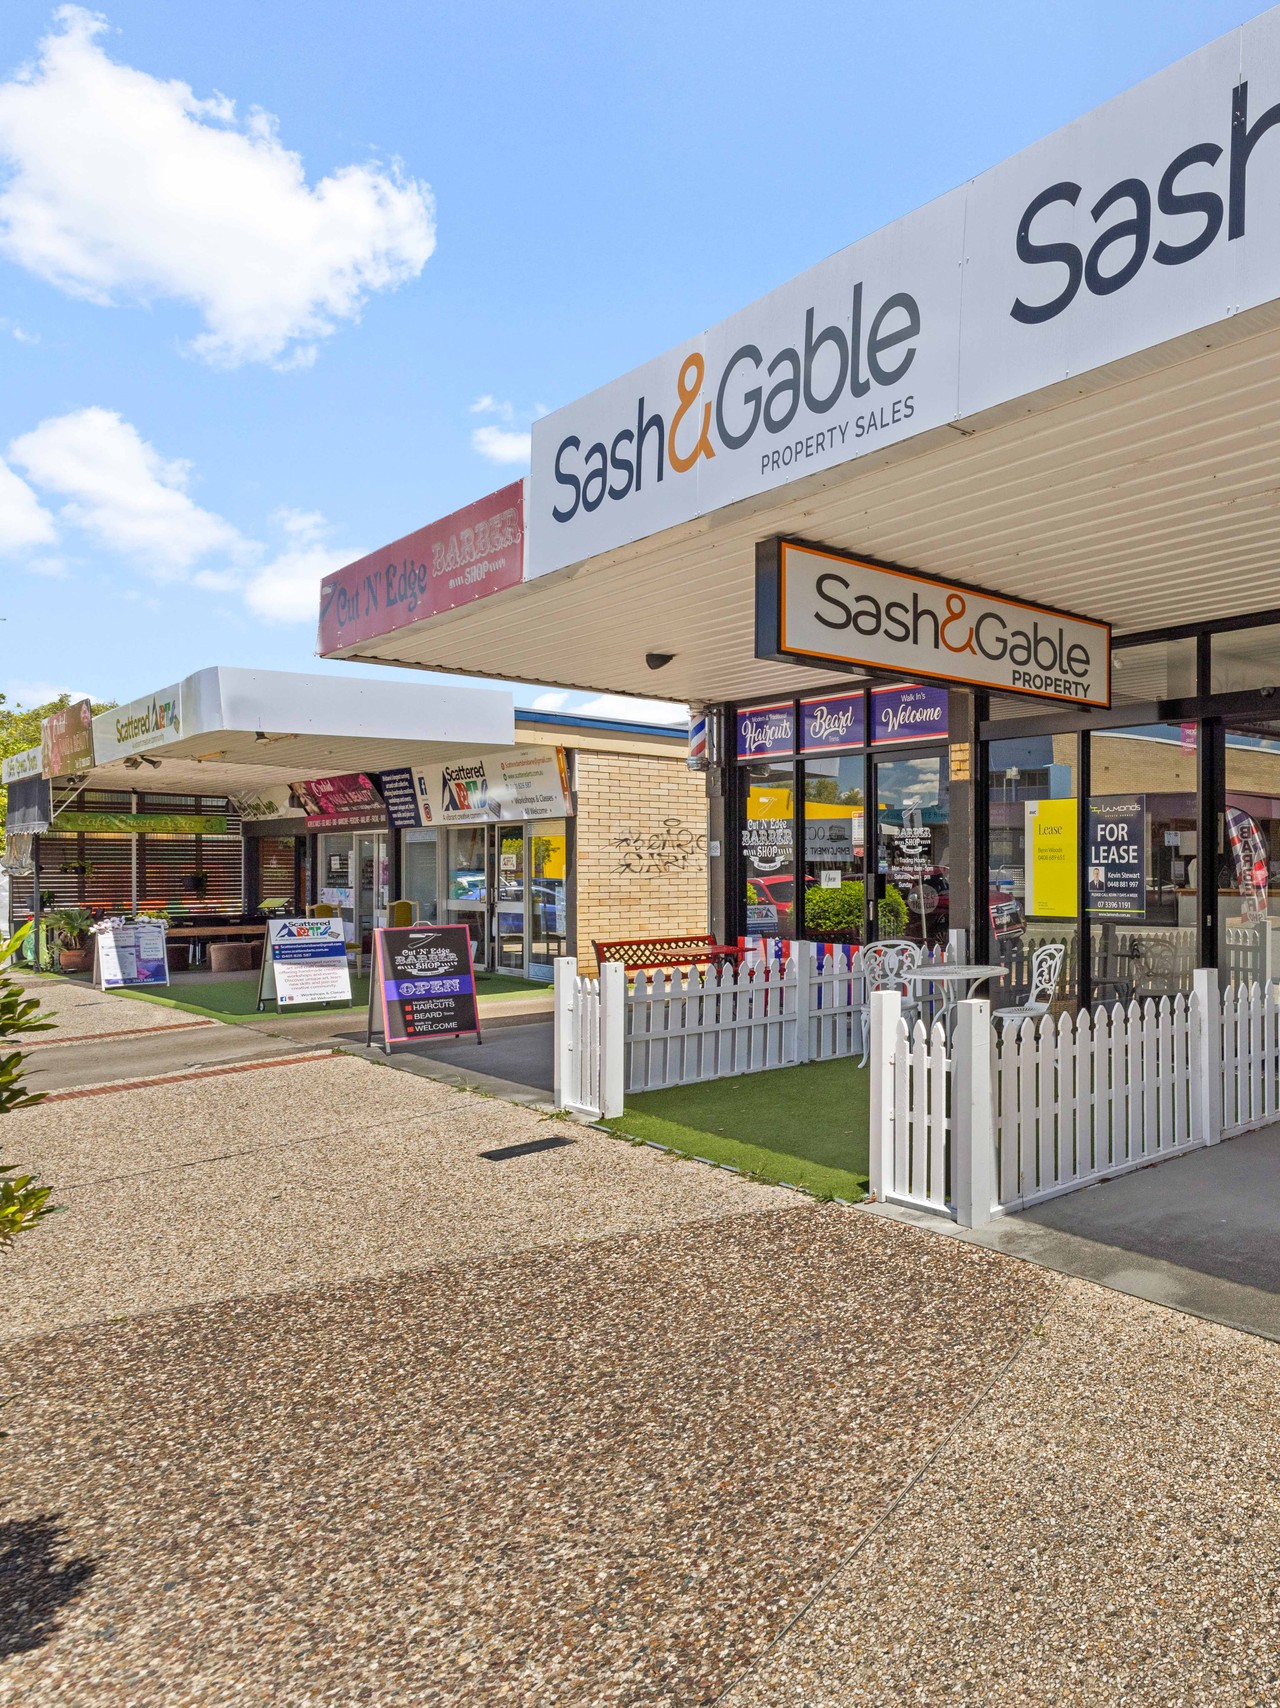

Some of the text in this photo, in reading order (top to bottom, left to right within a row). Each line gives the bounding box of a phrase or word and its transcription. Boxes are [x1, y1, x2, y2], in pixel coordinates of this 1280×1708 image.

[552, 281, 920, 523] Sash&Gable
[761, 395, 914, 475] PROPERTY SALES
[431, 507, 521, 577] BARBER
[465, 561, 489, 585] SHOP
[336, 587, 360, 627] Cut
[385, 559, 427, 612] Edge
[814, 573, 1090, 678] Sash&Gable
[1013, 670, 1090, 698] PROPERTY
[901, 692, 926, 702] Walk In's
[116, 705, 149, 743] Scattered
[810, 706, 854, 740] Beard
[881, 704, 942, 733] Welcome
[741, 719, 792, 752] Haircuts
[446, 761, 485, 781] Scattered
[350, 789, 374, 803] BEAUTY
[748, 819, 759, 830] Cut
[770, 818, 787, 829] Edge
[1038, 824, 1063, 835] Lease
[1097, 823, 1128, 841] FOR
[742, 829, 793, 846] BARBER
[757, 846, 778, 858] SHOP
[1092, 846, 1138, 864] LEASE
[395, 953, 458, 965] BARBER
[399, 979, 460, 996] OPEN
[413, 1001, 455, 1010] HAIRCUTS
[414, 1012, 442, 1020] BEARD
[415, 1022, 458, 1032] WELCOME
